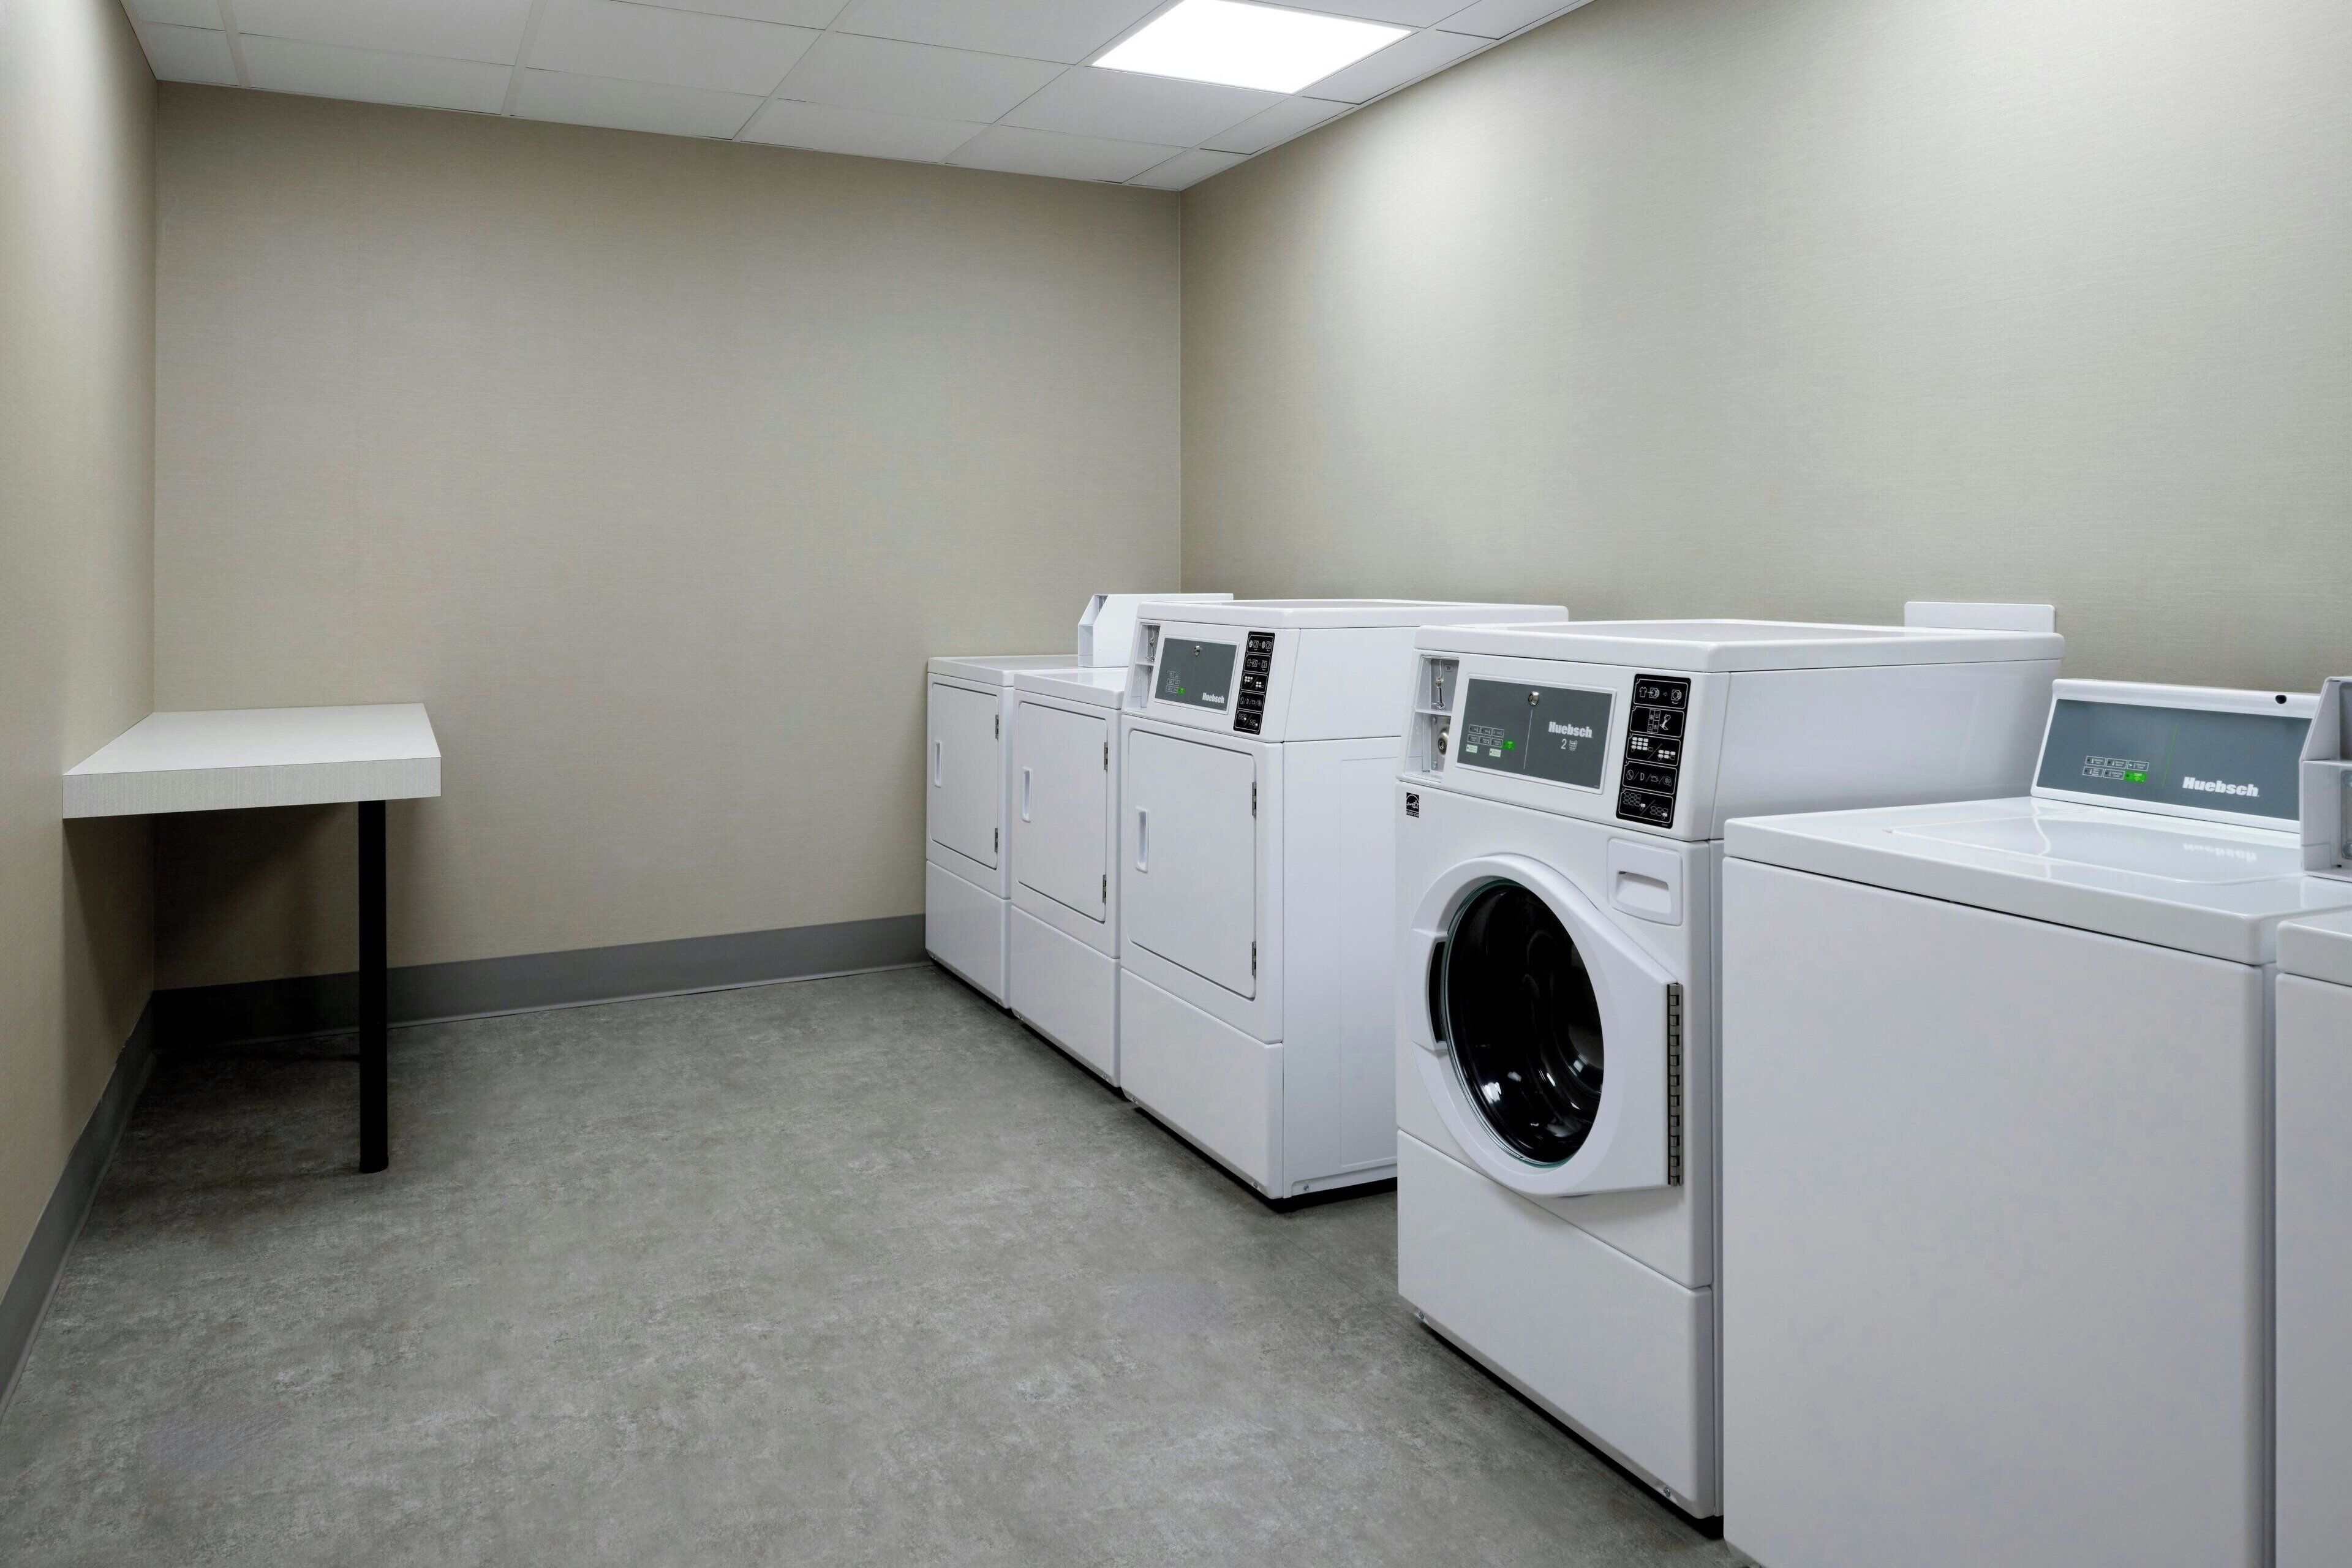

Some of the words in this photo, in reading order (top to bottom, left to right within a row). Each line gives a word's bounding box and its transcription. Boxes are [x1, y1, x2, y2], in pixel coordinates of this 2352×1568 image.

[1202, 692, 1224, 704] Huebsch
[1548, 722, 1593, 738] Huebsch
[1561, 738, 1567, 750] 2
[2182, 776, 2259, 797] Huebsch
